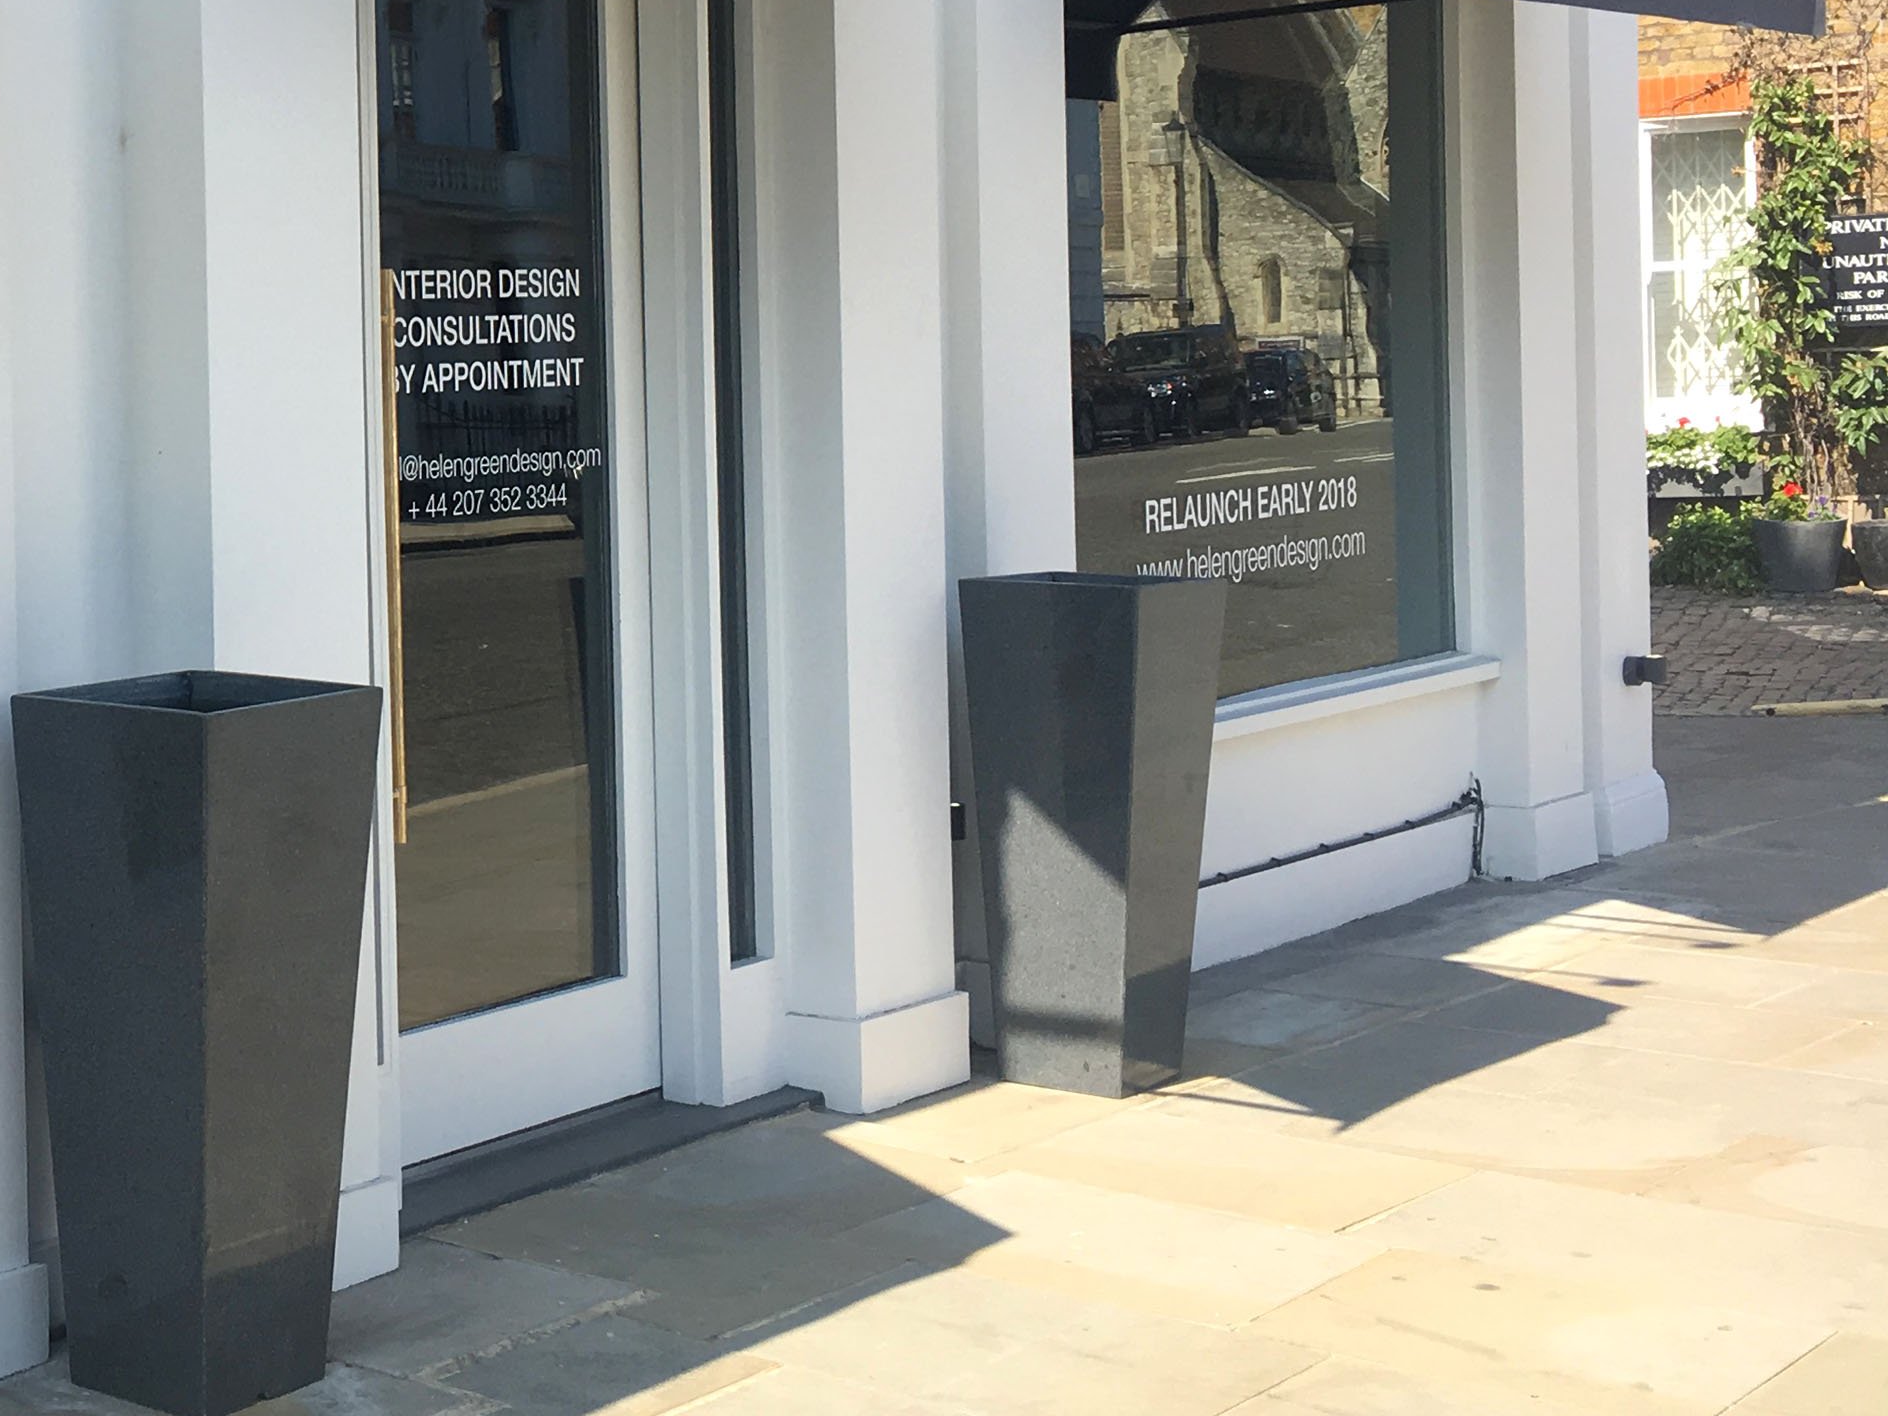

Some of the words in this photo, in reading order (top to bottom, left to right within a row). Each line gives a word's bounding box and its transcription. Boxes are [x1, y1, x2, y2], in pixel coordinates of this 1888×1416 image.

[1824, 218, 1888, 234] PRIVAT
[1822, 253, 1888, 270] UNAUT
[1853, 270, 1888, 285] PAR
[392, 269, 492, 300] NTERIOR
[499, 268, 580, 299] DESIGN
[1867, 289, 1885, 299] OF
[394, 313, 576, 348] CONSULTATIONS
[421, 358, 584, 393] APPOINTMENT
[399, 447, 602, 482] l@helengreendesign.com
[425, 493, 447, 518] 44
[452, 489, 485, 516] 207
[489, 486, 522, 513] 352
[526, 482, 568, 509] 3344
[1145, 488, 1252, 534] RELAUNCH
[1257, 480, 1314, 519] EARLY
[1318, 475, 1357, 511] 2018
[1136, 531, 1366, 583] wwwhelengreendesign.com
